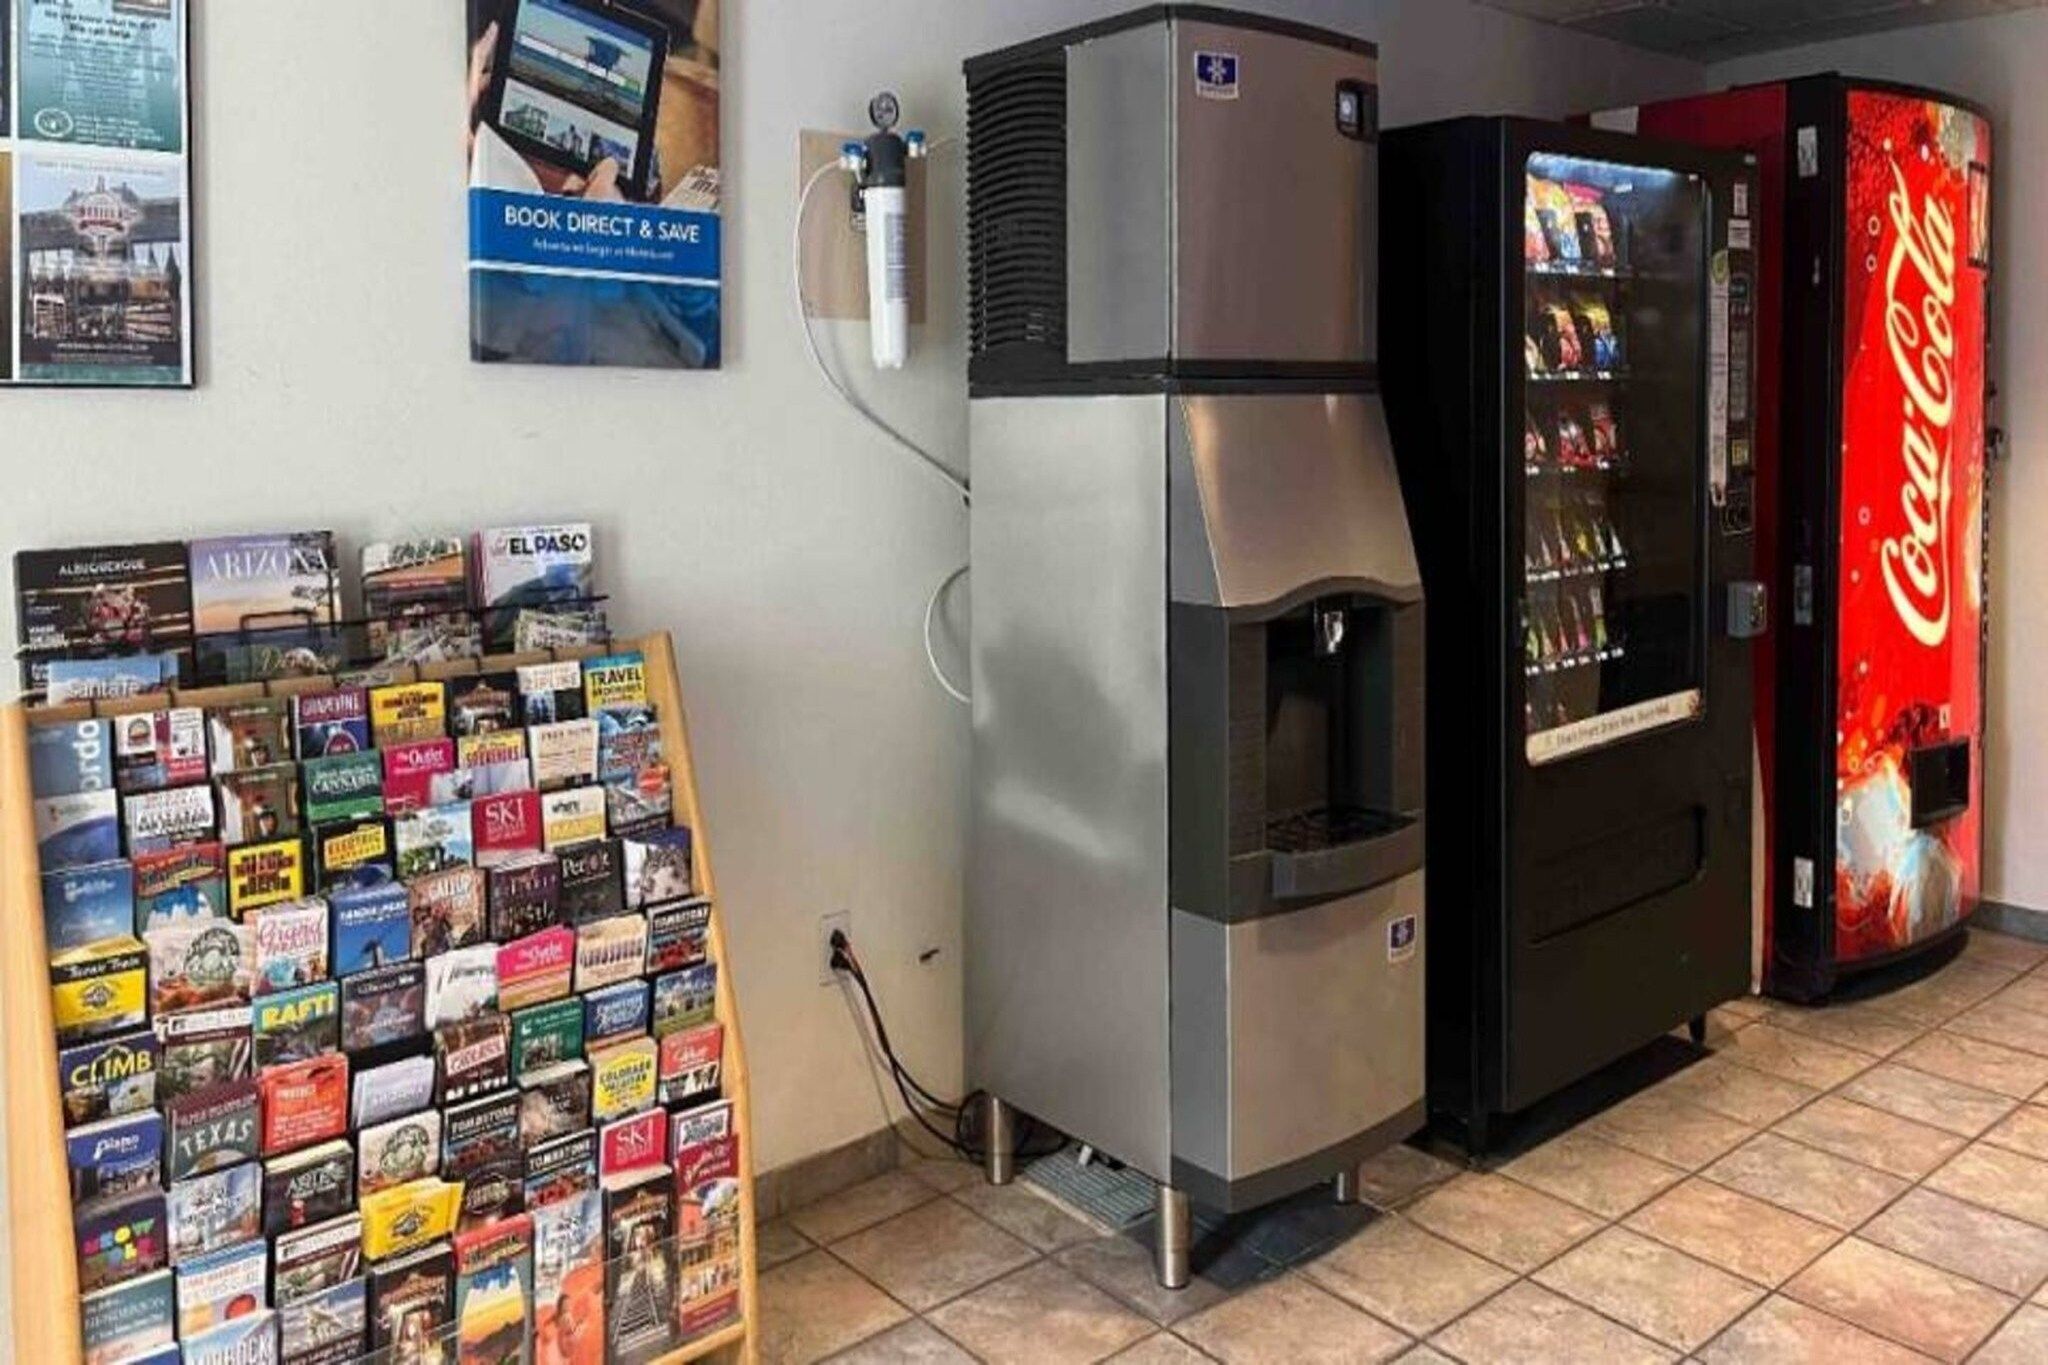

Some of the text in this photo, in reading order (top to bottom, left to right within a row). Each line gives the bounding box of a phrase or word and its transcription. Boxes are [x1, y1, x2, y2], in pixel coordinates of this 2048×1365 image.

[504, 203, 701, 244] BOOK DIRECT & SAVE
[1881, 155, 1954, 647] Coca-Cola
[509, 532, 587, 555] EL PASO
[58, 558, 147, 576] ALBUQUERQUE
[204, 548, 331, 582] ARIZONA
[590, 666, 642, 686] TRAVEL
[485, 797, 526, 823] SKI
[70, 1049, 152, 1088] CLIMB
[178, 1118, 254, 1158] TEXAS
